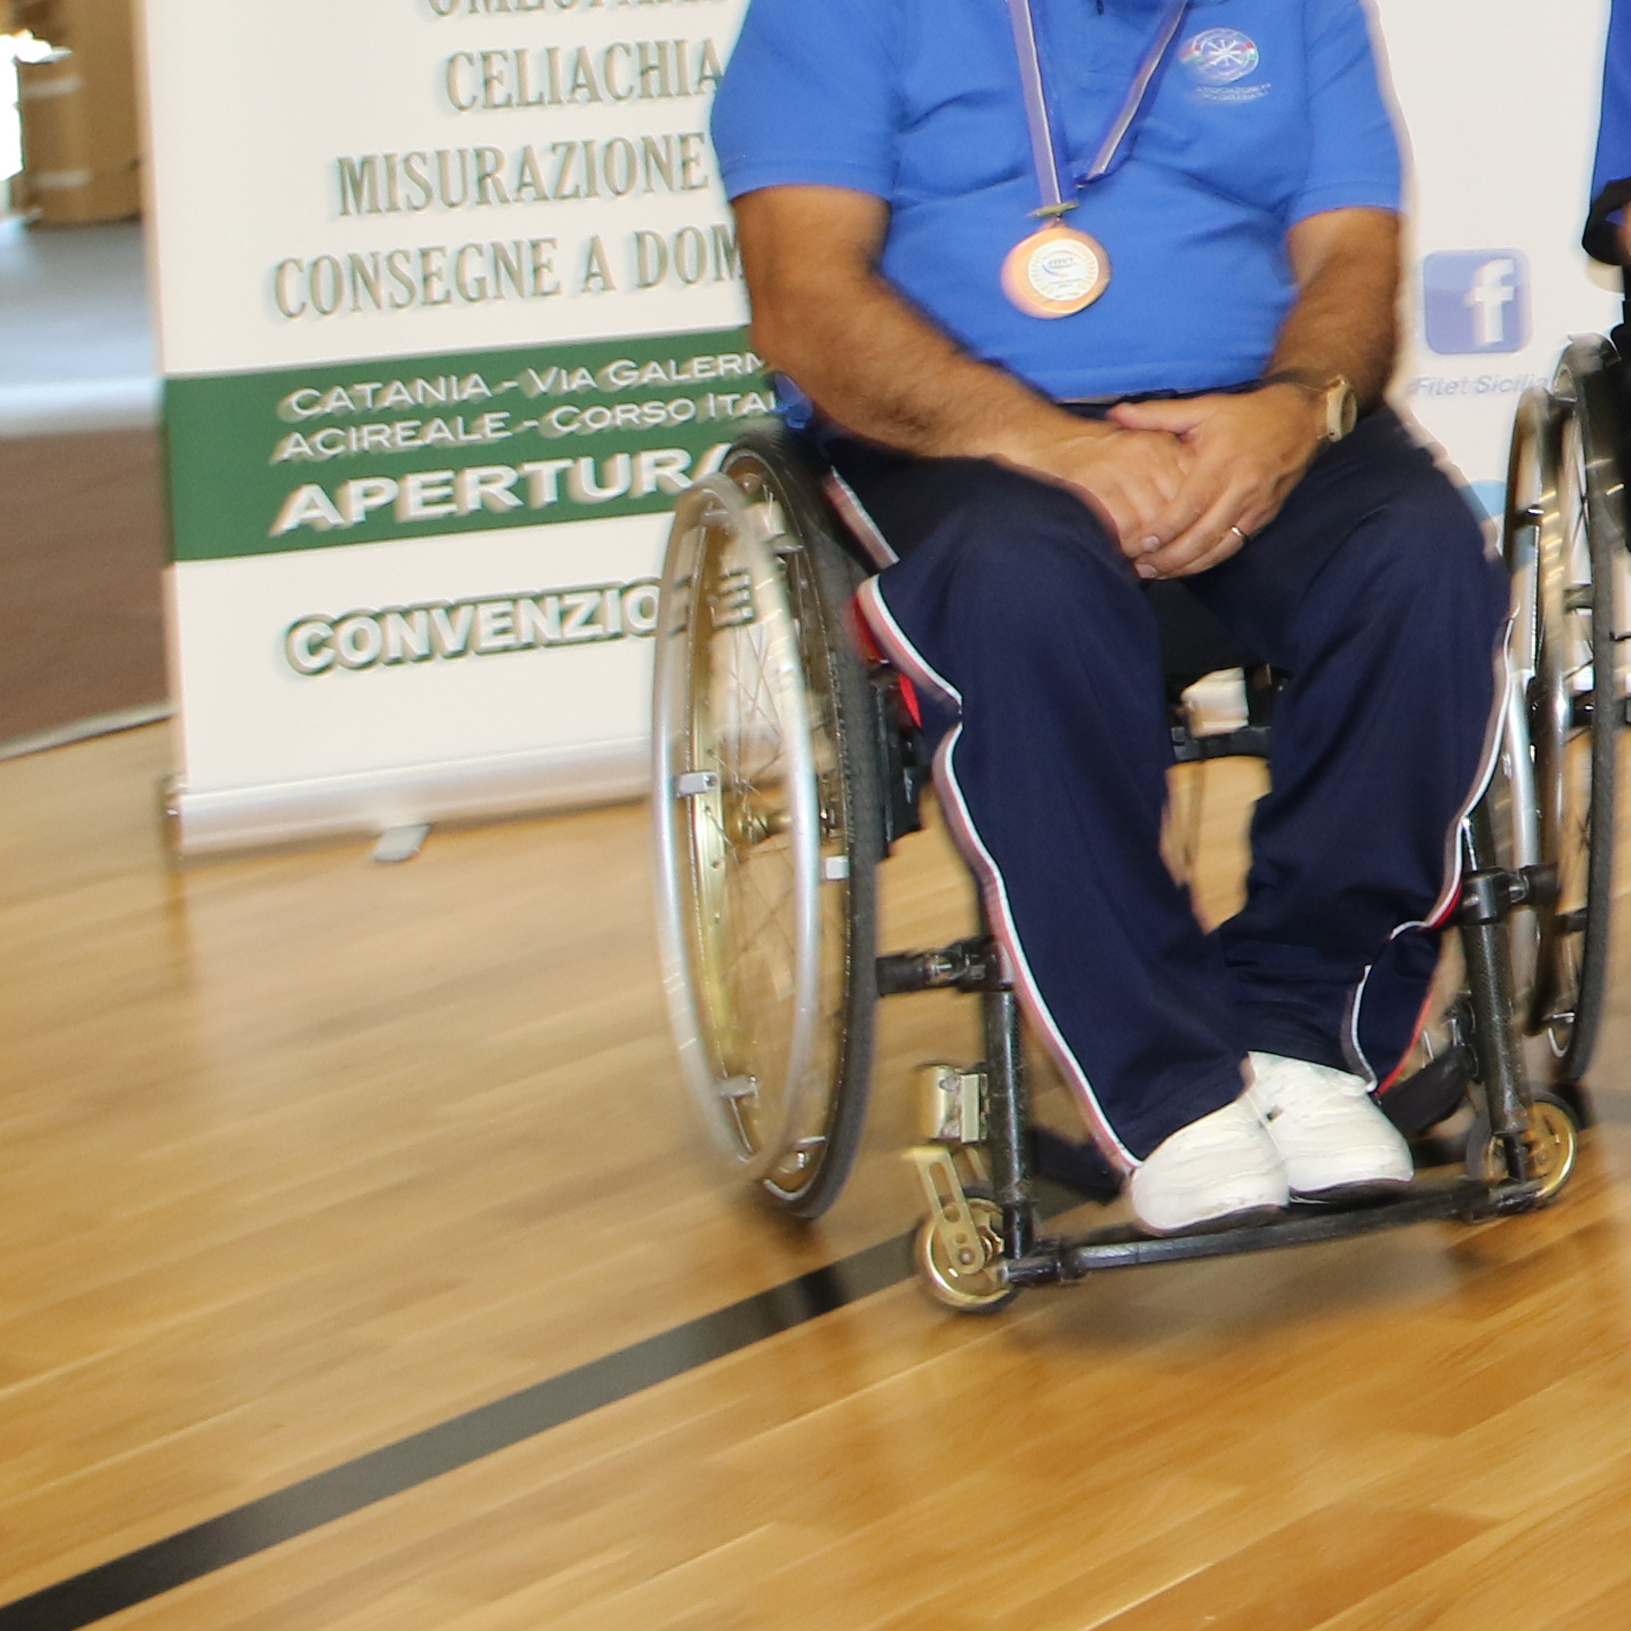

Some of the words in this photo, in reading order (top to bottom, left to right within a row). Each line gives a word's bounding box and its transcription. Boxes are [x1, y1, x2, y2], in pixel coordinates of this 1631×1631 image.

[444, 39, 724, 113] CELIACHIA
[336, 132, 710, 218] MISURAZIONE
[273, 237, 562, 319] CONSEGNE
[580, 235, 617, 293] A
[285, 373, 491, 418] CATANIA
[1410, 375, 1469, 396] Fitet
[274, 411, 514, 462] ACIREALE
[549, 397, 698, 436] CORSO
[287, 568, 757, 675] CONVENZIOE
